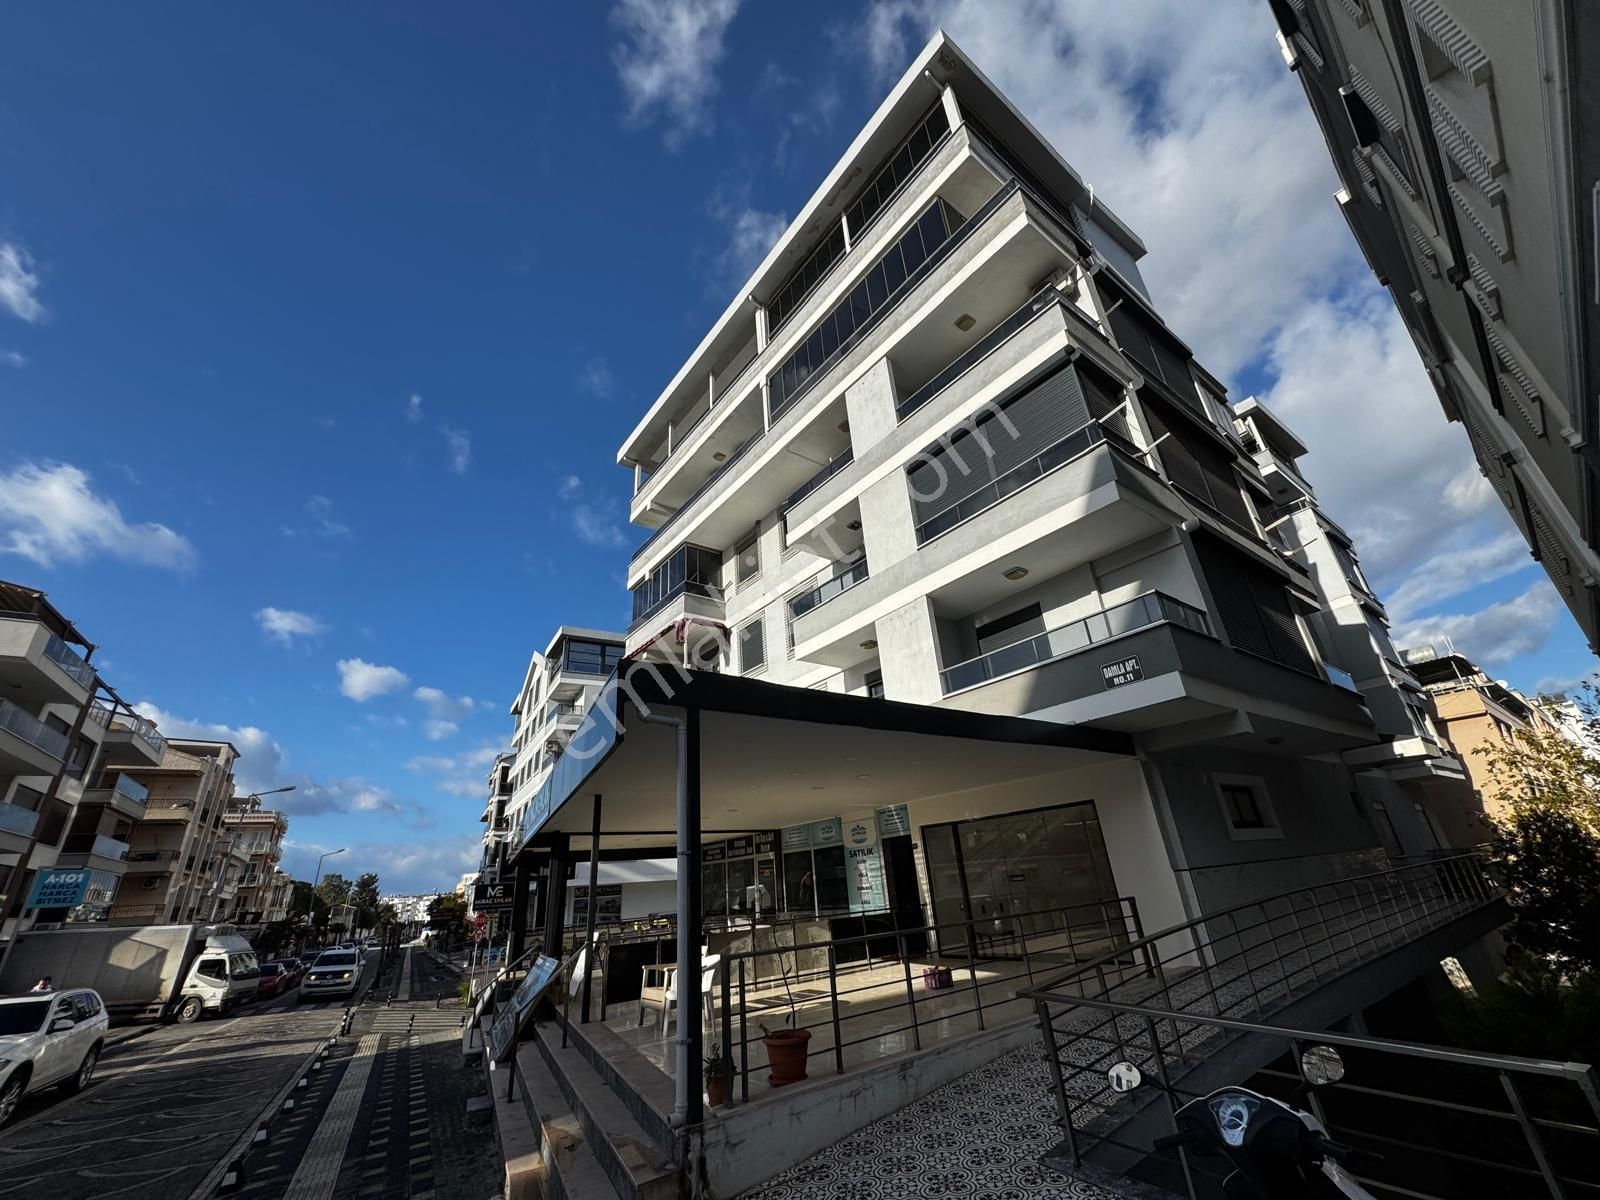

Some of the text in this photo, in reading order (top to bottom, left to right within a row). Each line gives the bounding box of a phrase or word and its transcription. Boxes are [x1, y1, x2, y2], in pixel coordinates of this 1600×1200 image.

[1103, 659, 1140, 678] DAMLA APT.
[1113, 673, 1134, 685] NO.11
[849, 847, 874, 858] SATILIK
[42, 882, 80, 890] HARCA
